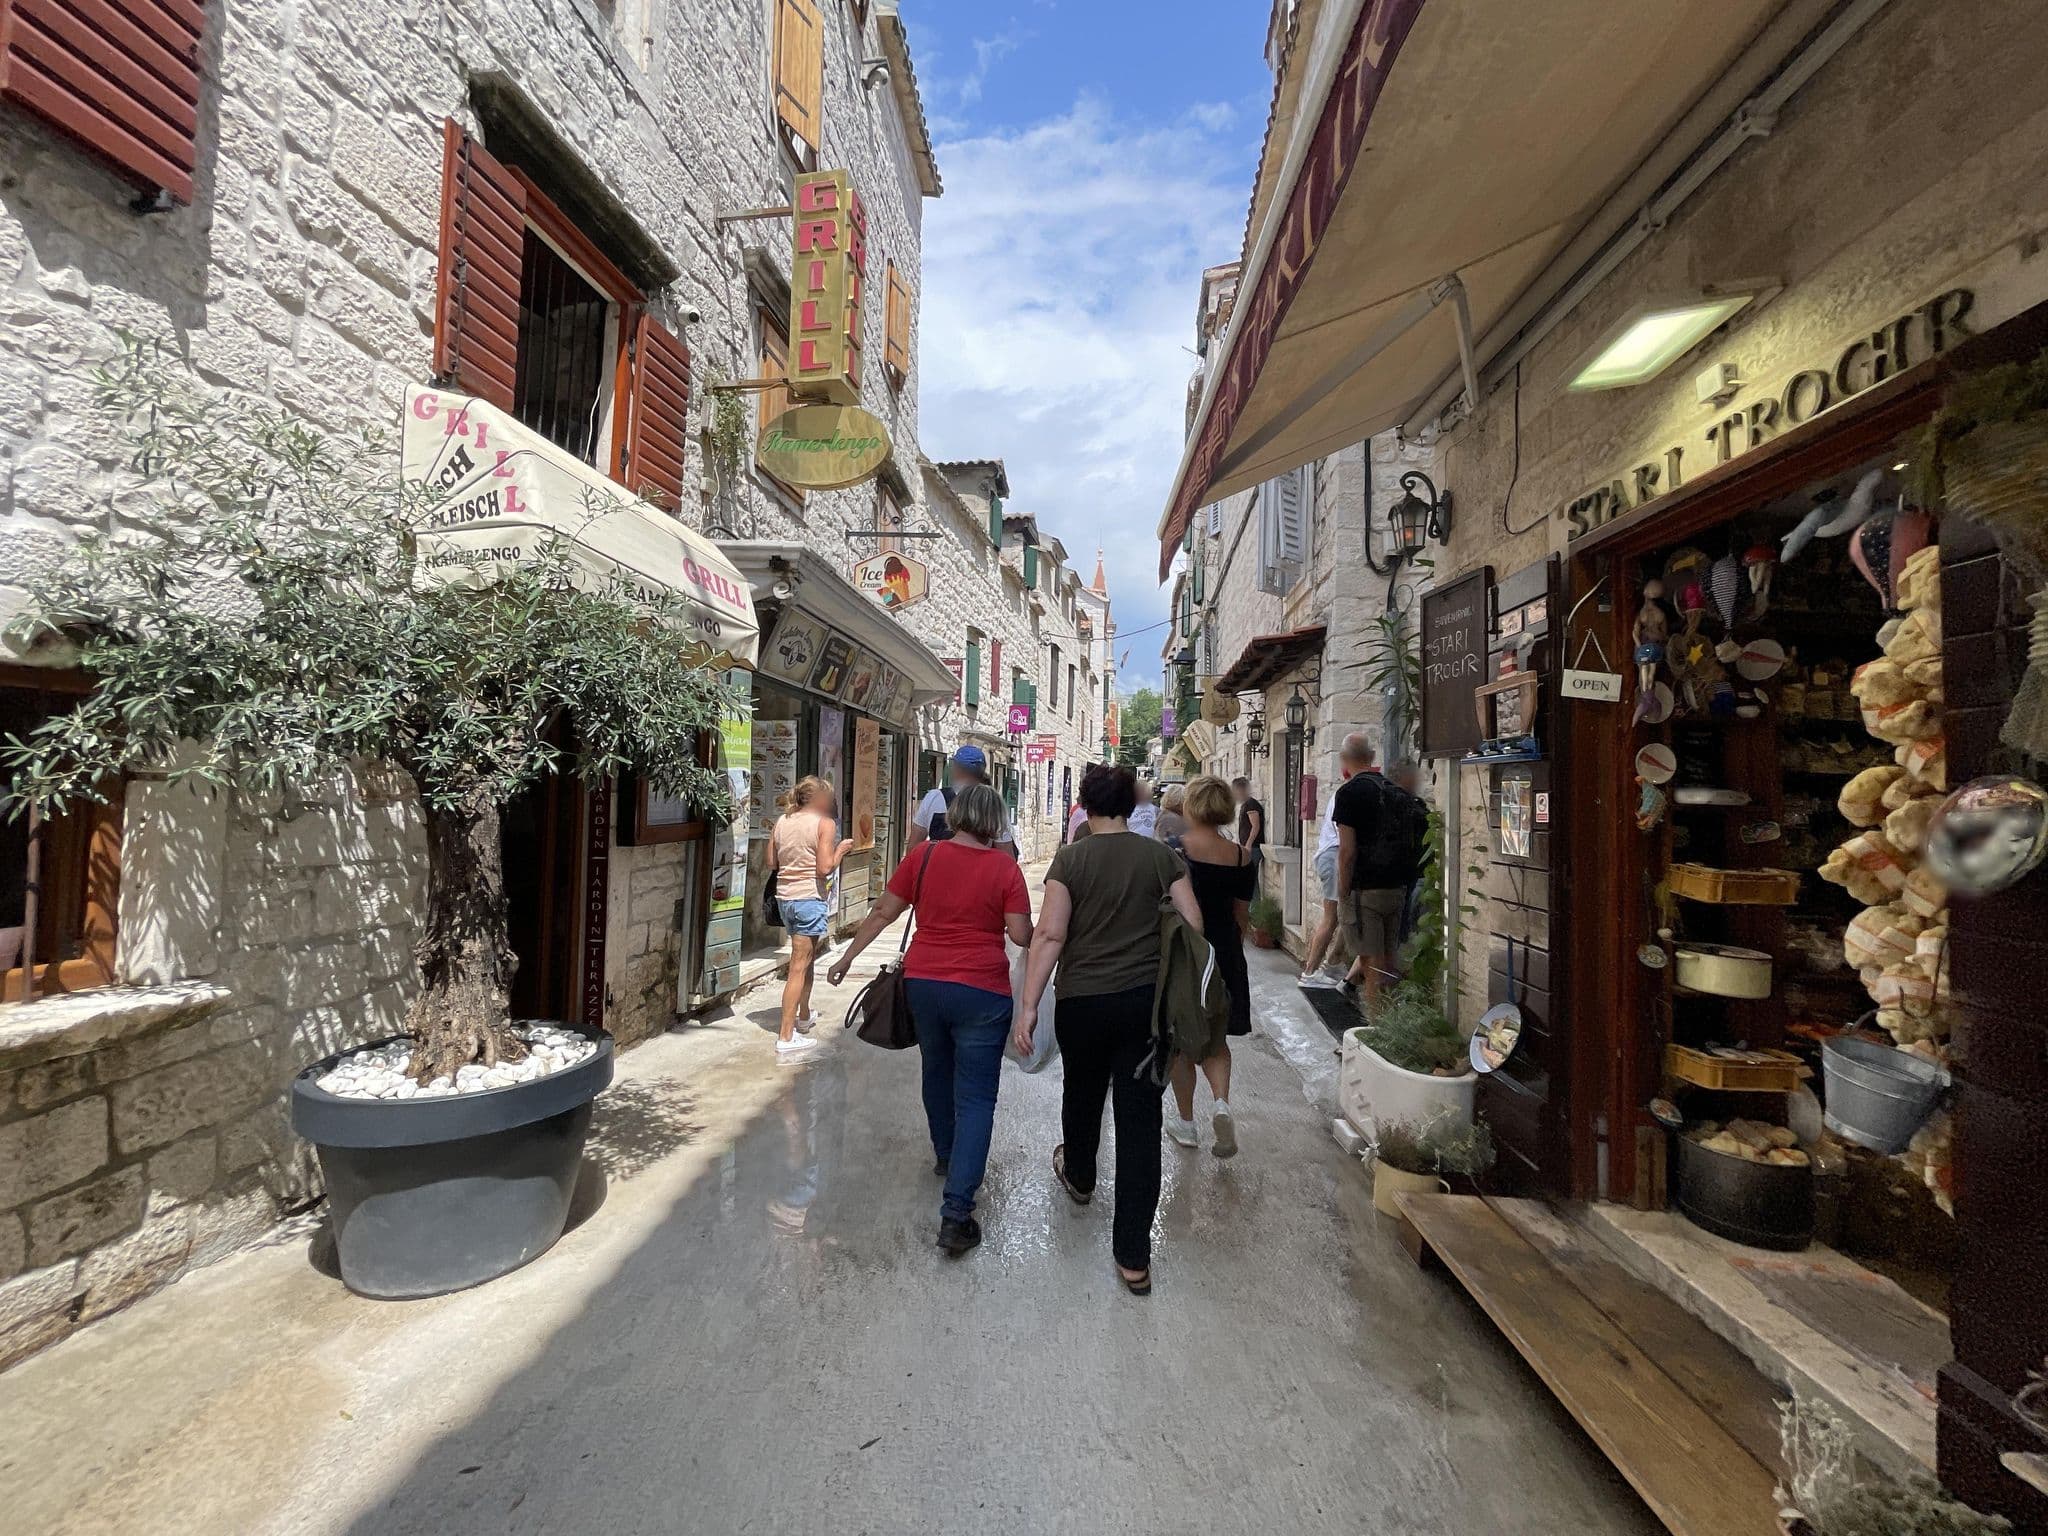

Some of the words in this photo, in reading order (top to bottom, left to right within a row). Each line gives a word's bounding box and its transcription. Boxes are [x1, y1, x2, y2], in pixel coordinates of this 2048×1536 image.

[798, 180, 841, 373] GRILL
[1567, 446, 1685, 542] STARI
[1706, 288, 1979, 460] TROGIR
[413, 393, 526, 513] GRILL
[434, 443, 476, 496] SCH
[682, 557, 747, 610] GRILL
[860, 566, 883, 581] Ice
[1432, 627, 1469, 657] STARI
[1424, 653, 1480, 685] TROGIR
[1572, 678, 1610, 692] OPEN
[594, 787, 605, 849] ARDEN
